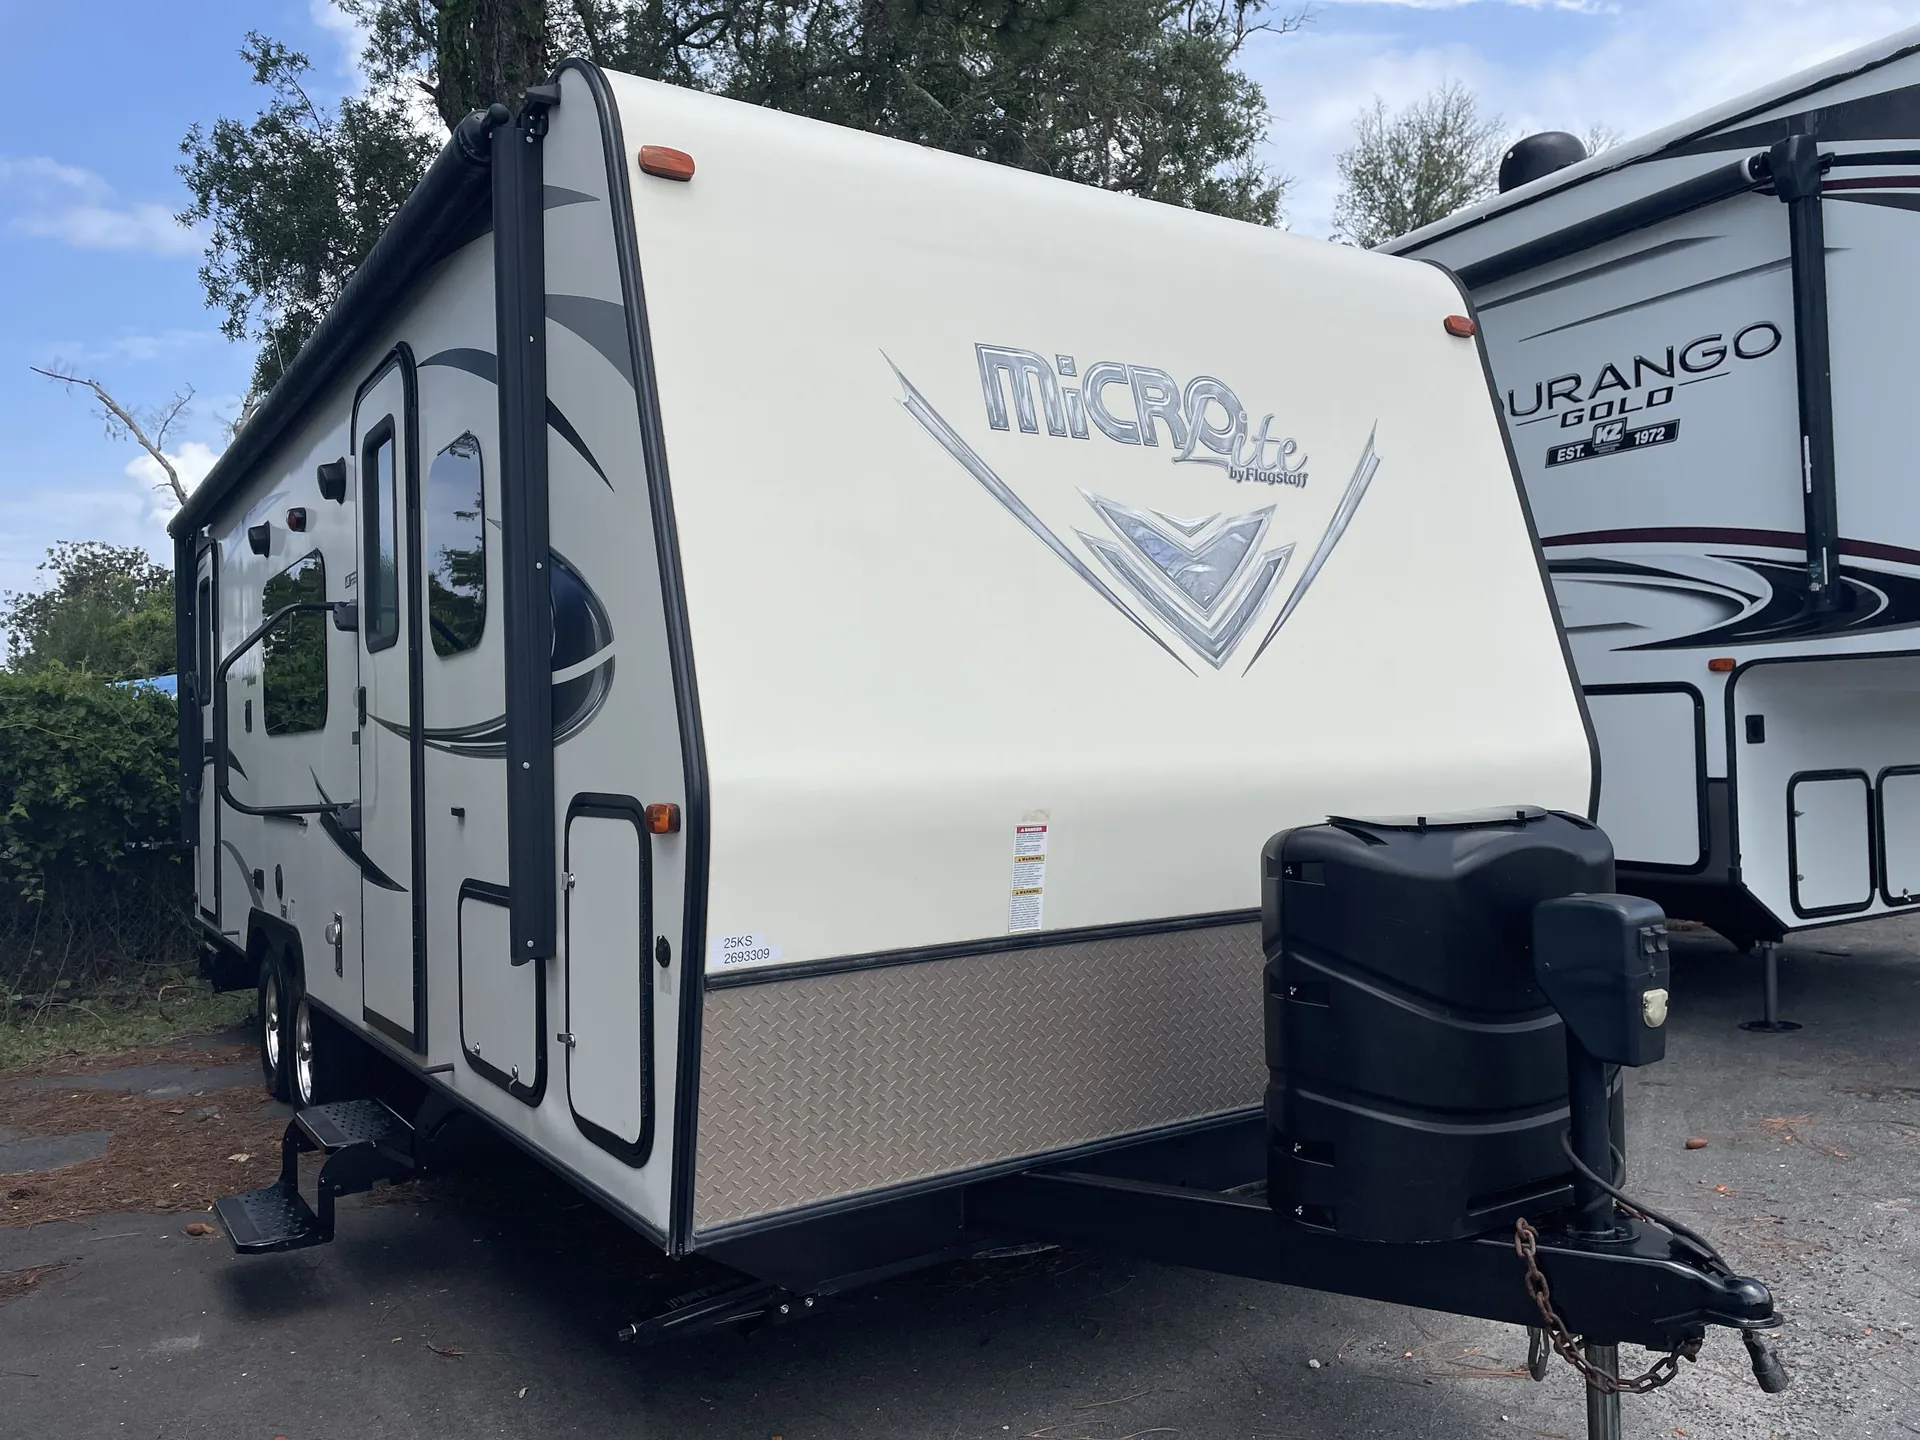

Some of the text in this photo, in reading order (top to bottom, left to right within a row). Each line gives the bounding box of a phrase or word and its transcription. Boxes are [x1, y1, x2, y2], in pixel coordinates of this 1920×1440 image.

[1500, 321, 1782, 417] URANGO
[1560, 386, 1674, 428] GOLD
[1556, 444, 1585, 462] EST.
[1594, 422, 1623, 445] KZ
[1634, 427, 1665, 446] 1972
[1229, 466, 1309, 489] by Flagstaff
[723, 935, 753, 949] 25KS
[723, 948, 770, 965] 2693309
